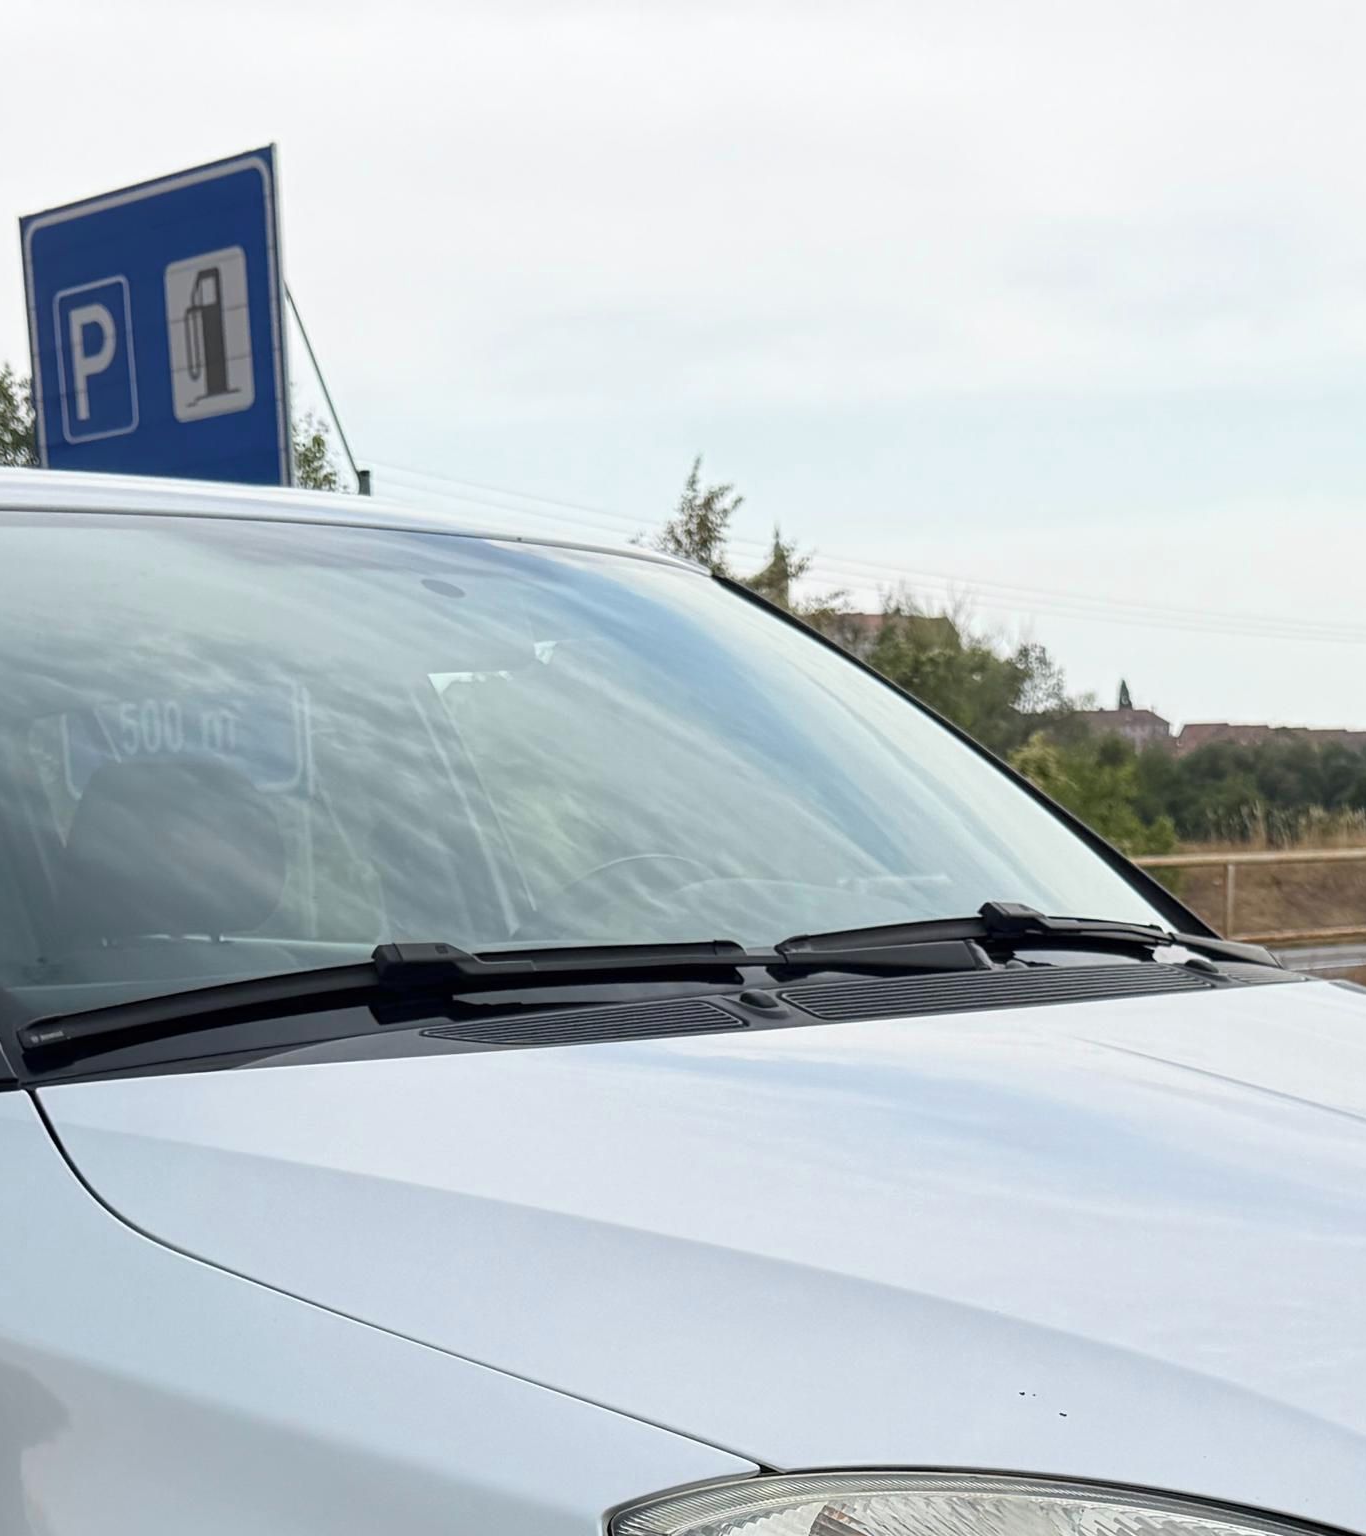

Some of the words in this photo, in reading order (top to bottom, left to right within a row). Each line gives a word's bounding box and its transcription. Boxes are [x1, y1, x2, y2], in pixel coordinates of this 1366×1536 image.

[68, 303, 116, 421] P
[117, 698, 185, 755] 500
[200, 709, 236, 750] m
